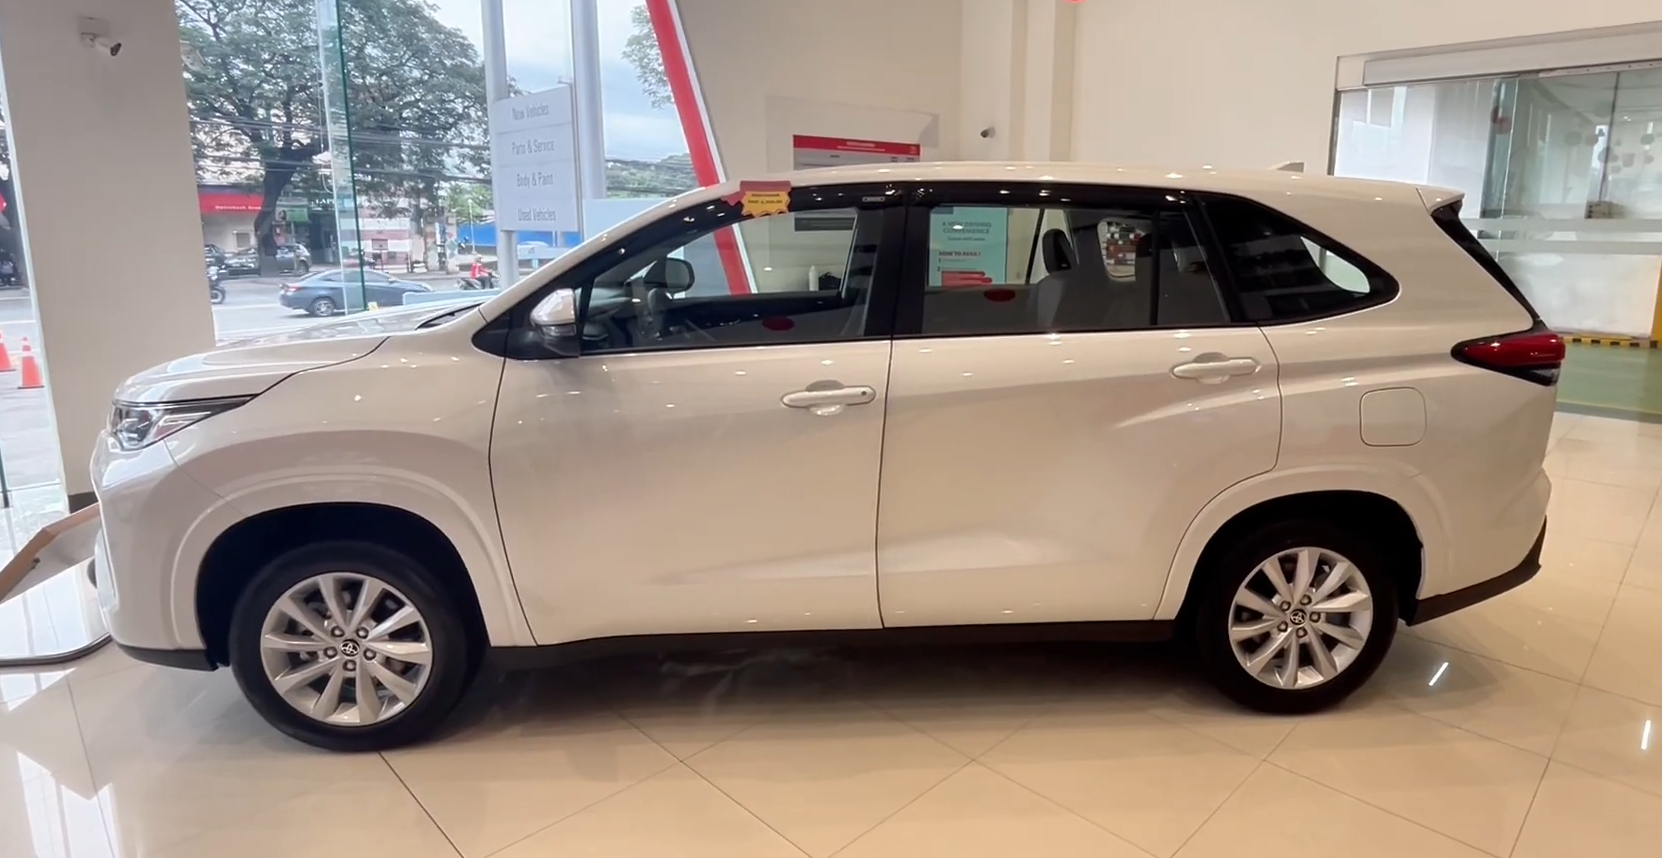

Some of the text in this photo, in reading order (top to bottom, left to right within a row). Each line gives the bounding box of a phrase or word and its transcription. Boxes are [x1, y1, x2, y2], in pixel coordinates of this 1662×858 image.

[512, 103, 549, 121] New Vehicles
[512, 142, 526, 156] Parts
[534, 139, 555, 153] Service
[517, 172, 554, 189] Body & Paint
[518, 208, 556, 222] Used Vehicles
